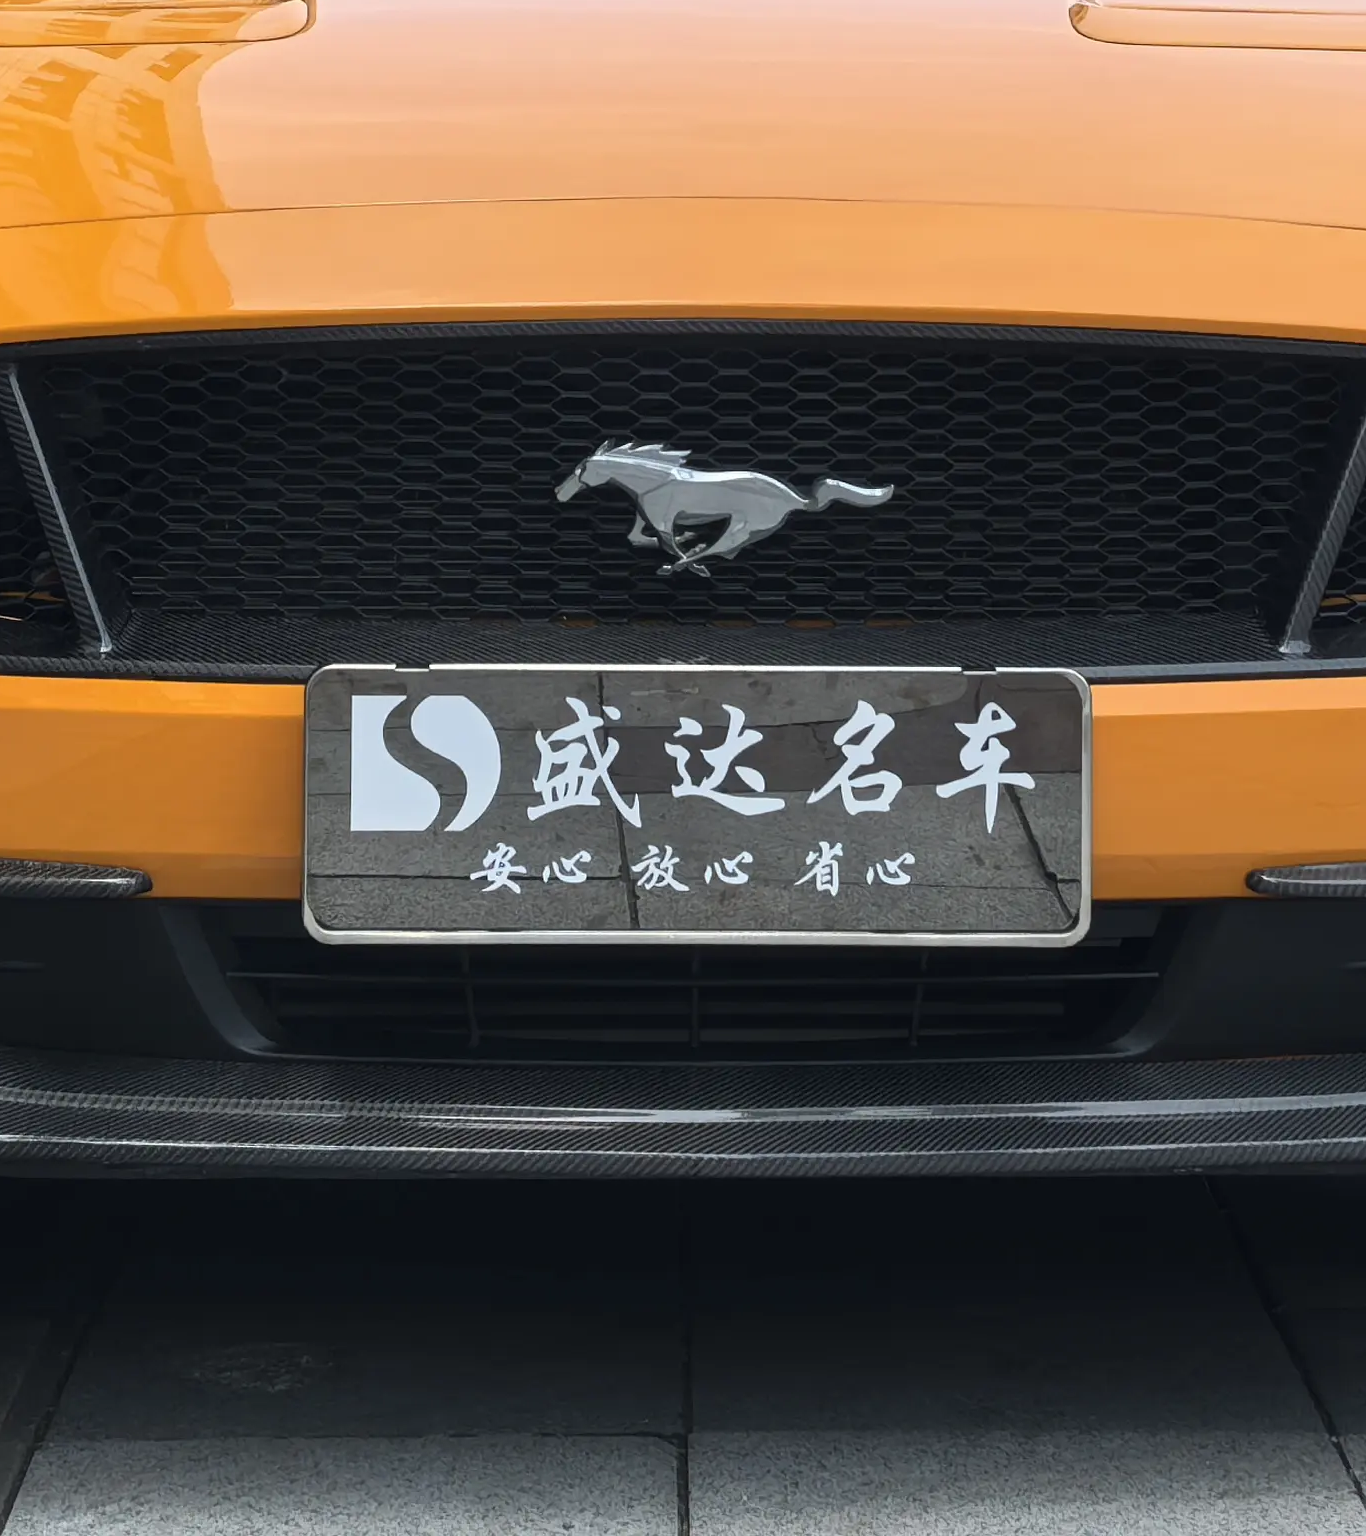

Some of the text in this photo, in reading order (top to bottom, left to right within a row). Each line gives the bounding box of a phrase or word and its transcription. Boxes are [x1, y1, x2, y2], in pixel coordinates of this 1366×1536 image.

[527, 696, 1036, 834] 盛达名车
[470, 840, 916, 896] 安心 放心 省心
